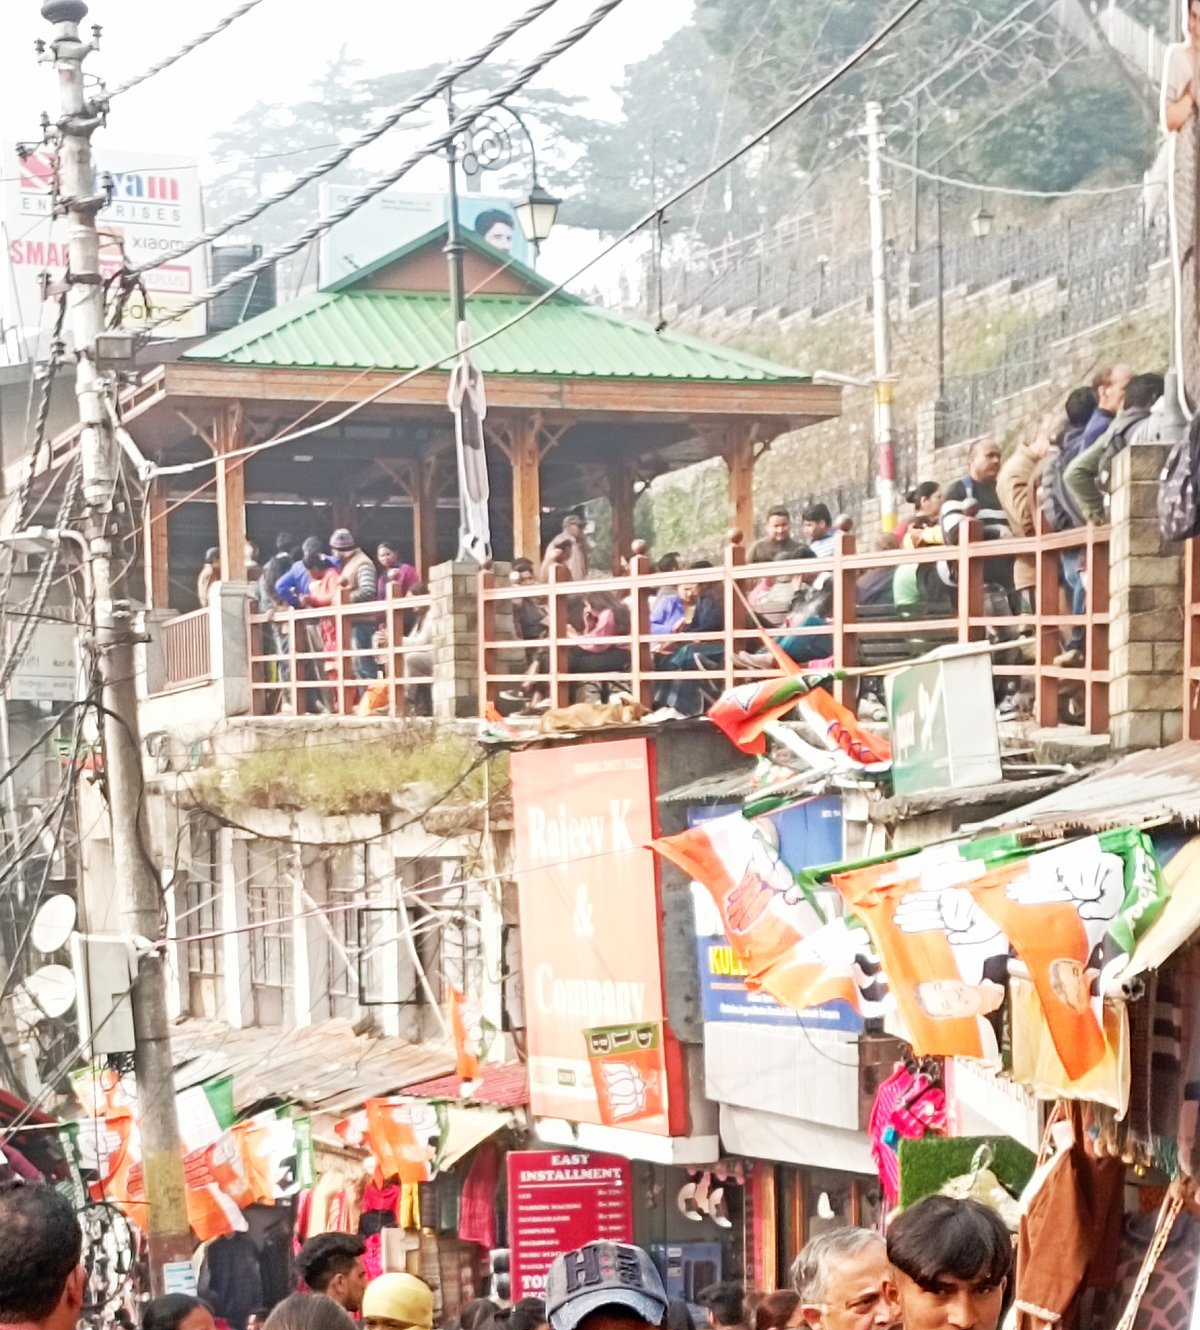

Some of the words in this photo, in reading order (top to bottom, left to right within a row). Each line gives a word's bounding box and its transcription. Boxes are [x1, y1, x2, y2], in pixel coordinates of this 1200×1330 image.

[131, 235, 188, 252] xiaom
[528, 803, 604, 871] Rajeev
[610, 799, 634, 858] K
[573, 883, 596, 937] &
[708, 945, 748, 976] KUL
[534, 963, 646, 1027] Company
[520, 1168, 622, 1182] INSTALLMENT
[551, 1154, 591, 1166] EASY
